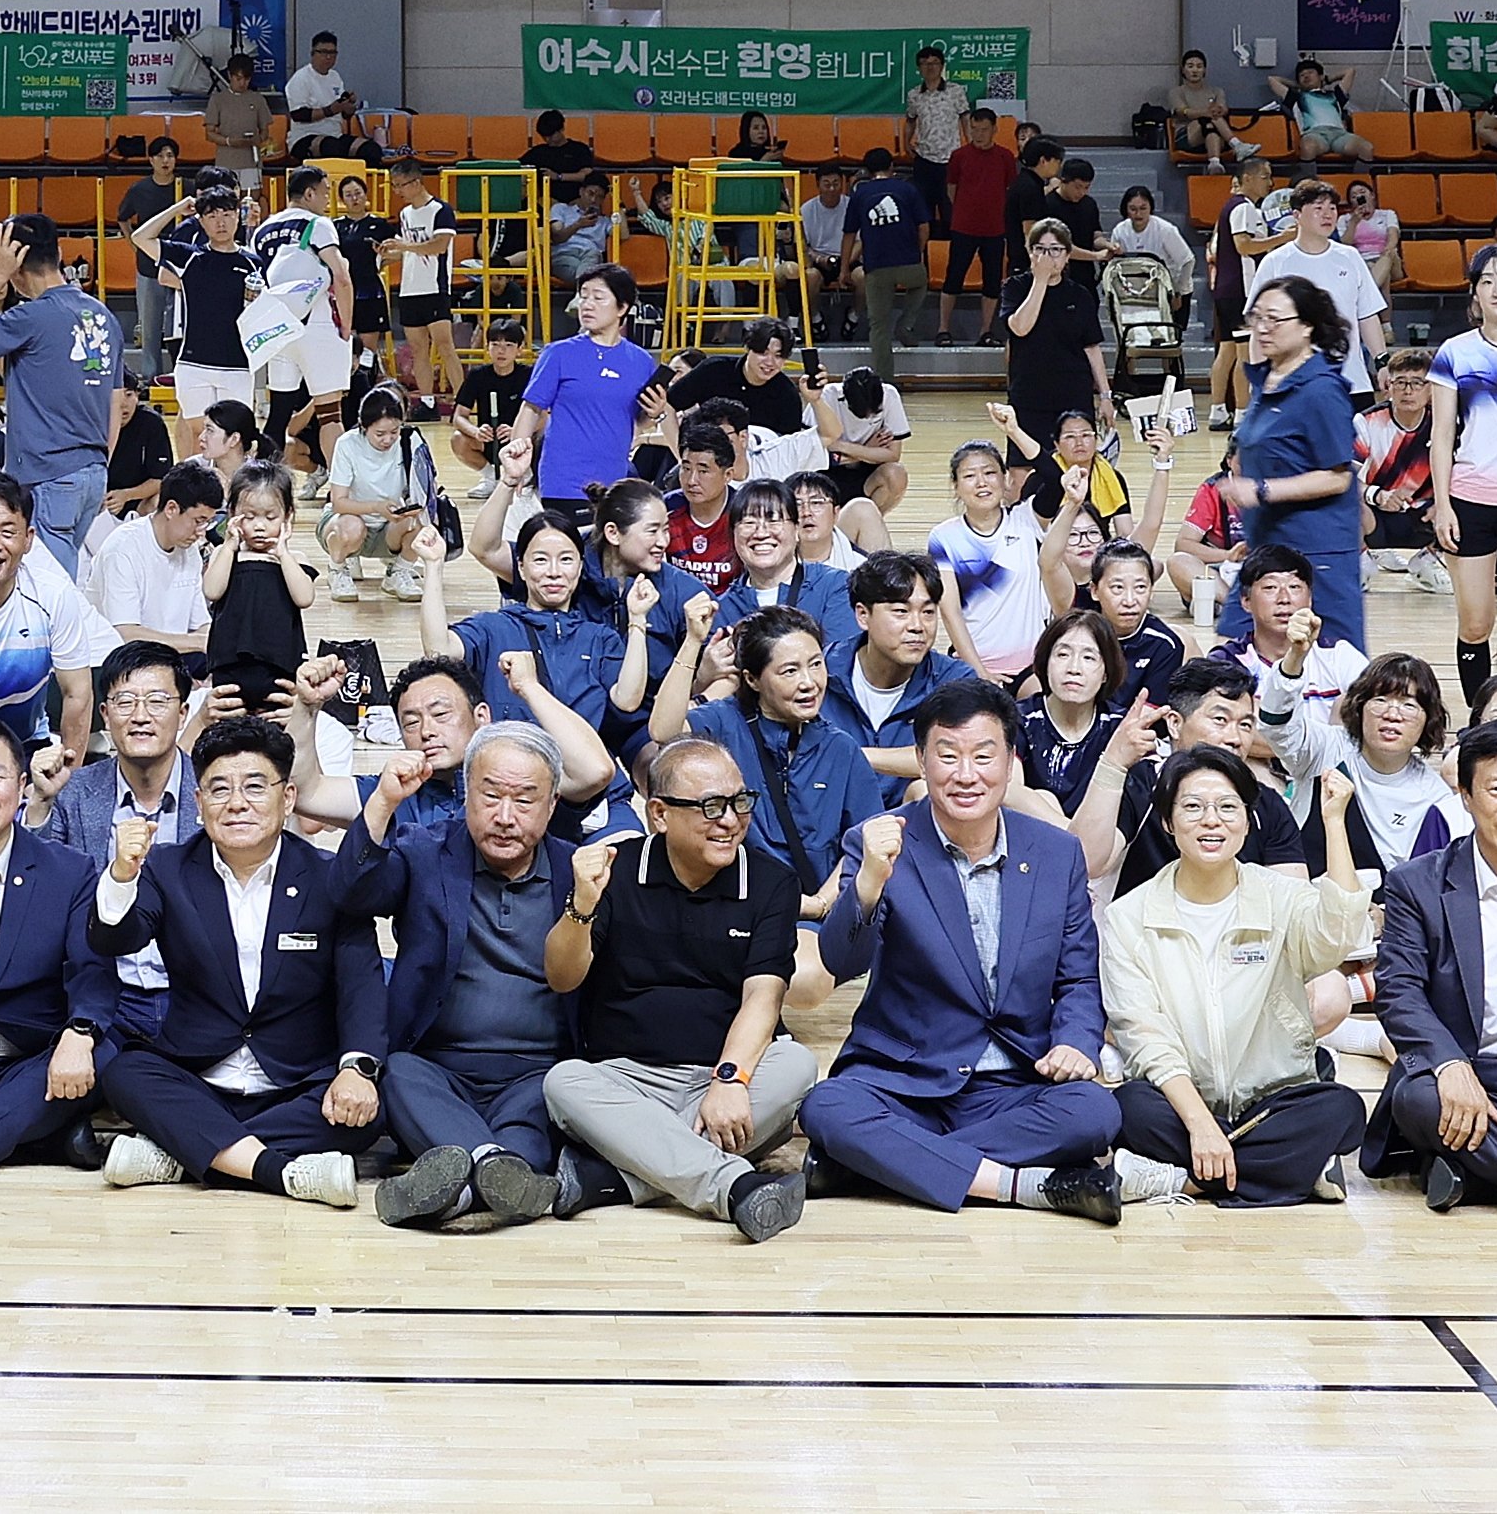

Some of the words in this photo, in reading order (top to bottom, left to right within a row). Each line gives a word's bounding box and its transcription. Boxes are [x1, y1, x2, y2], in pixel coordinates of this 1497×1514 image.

[62, 50, 115, 64] 천사푸드
[538, 37, 729, 78] 여수시선수단
[736, 40, 894, 80] 환영합니다
[659, 90, 797, 108] 전라남도배드민턴협회
[714, 562, 731, 573] TO
